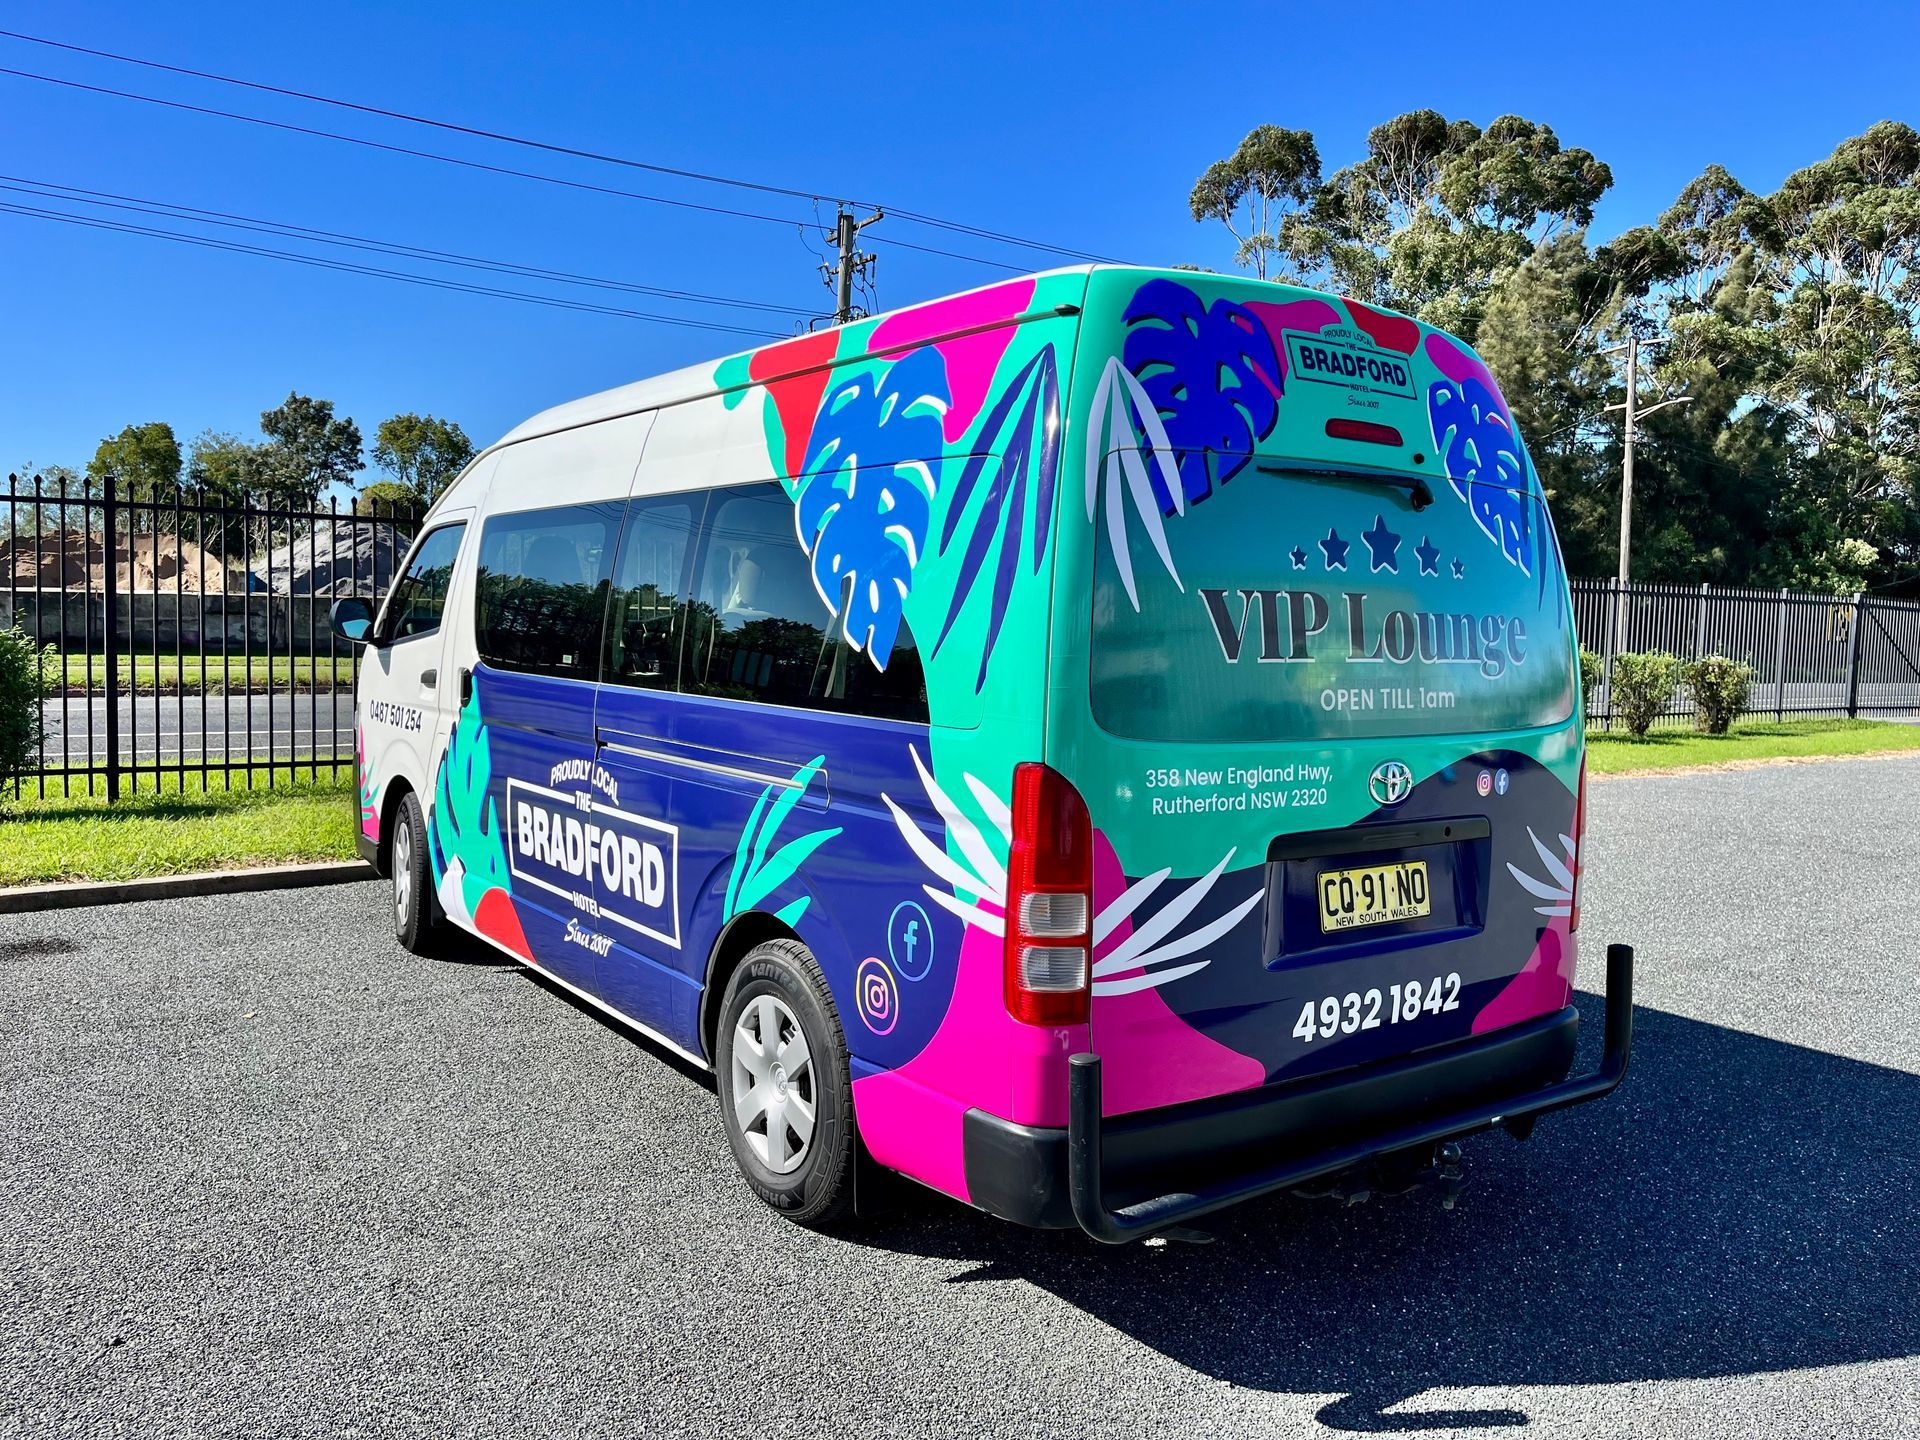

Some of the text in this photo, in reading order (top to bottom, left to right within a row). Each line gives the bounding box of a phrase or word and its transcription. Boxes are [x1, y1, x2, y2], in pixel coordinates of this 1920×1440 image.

[1324, 329, 1374, 349] PROUDLY LOCAL
[1345, 342, 1357, 352] THE
[1299, 345, 1407, 387] BRADFORD
[1349, 383, 1371, 393] HOTEL
[1198, 589, 1528, 680] VIP Lounge
[1320, 688, 1456, 712] OPEN TILL 1am
[370, 699, 422, 733] 0487 501 254
[550, 759, 619, 806] PROUDLY LOCAL
[1146, 763, 1333, 789] 358 New England Hwy,
[575, 790, 591, 813] THE
[1152, 788, 1328, 815] Rutherford NSW 2320
[517, 801, 665, 908] BRADFORD
[572, 891, 601, 918] HOTEL
[1336, 906, 1418, 927] NEW SOUTH WALES
[564, 918, 617, 957] Since 2007
[1292, 972, 1461, 1042] 4932 1842
